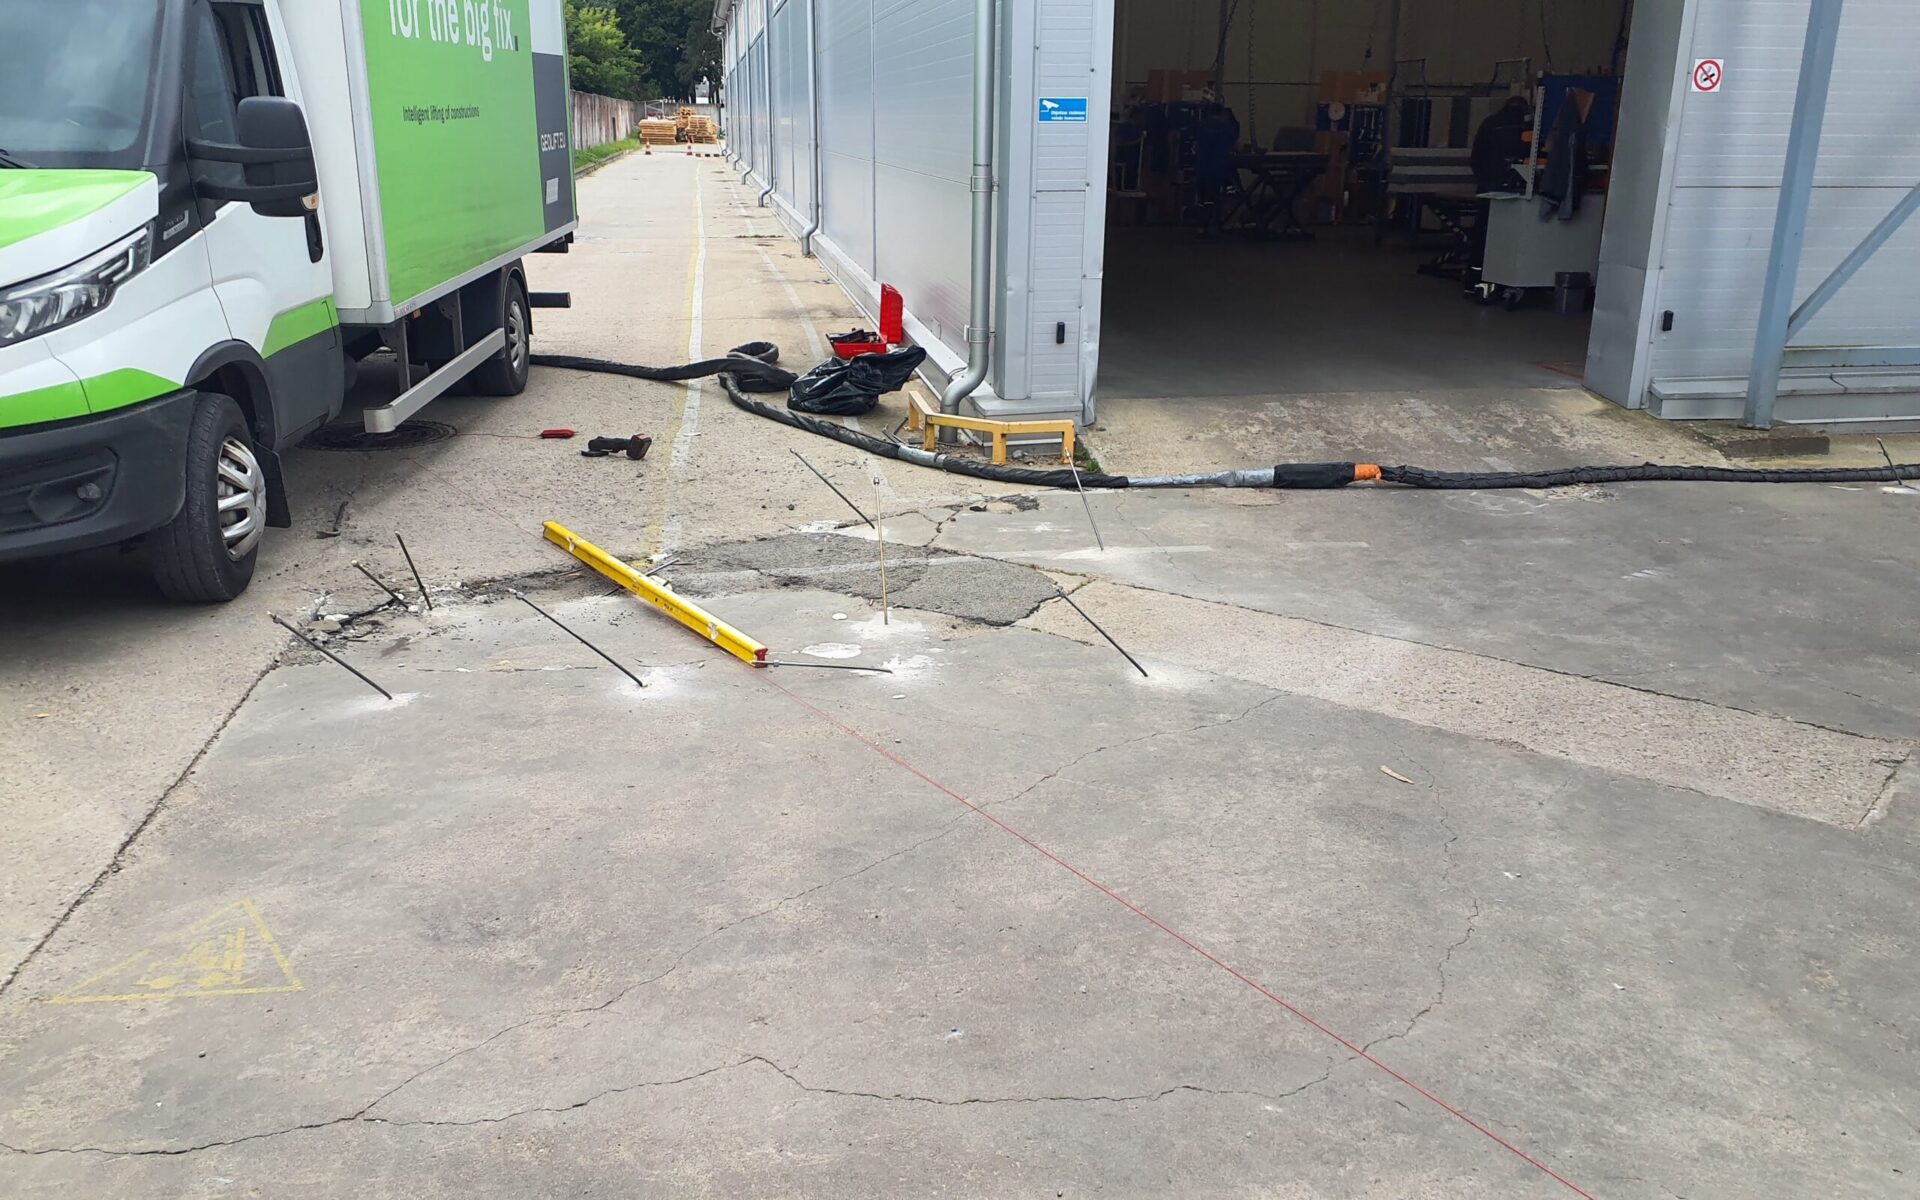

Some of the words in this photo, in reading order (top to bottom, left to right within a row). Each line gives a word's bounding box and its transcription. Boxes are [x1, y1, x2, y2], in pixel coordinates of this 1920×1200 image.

[427, 0, 459, 44] the
[464, 0, 492, 62] big
[403, 105, 430, 125] Intelligent
[450, 104, 480, 120] constructions
